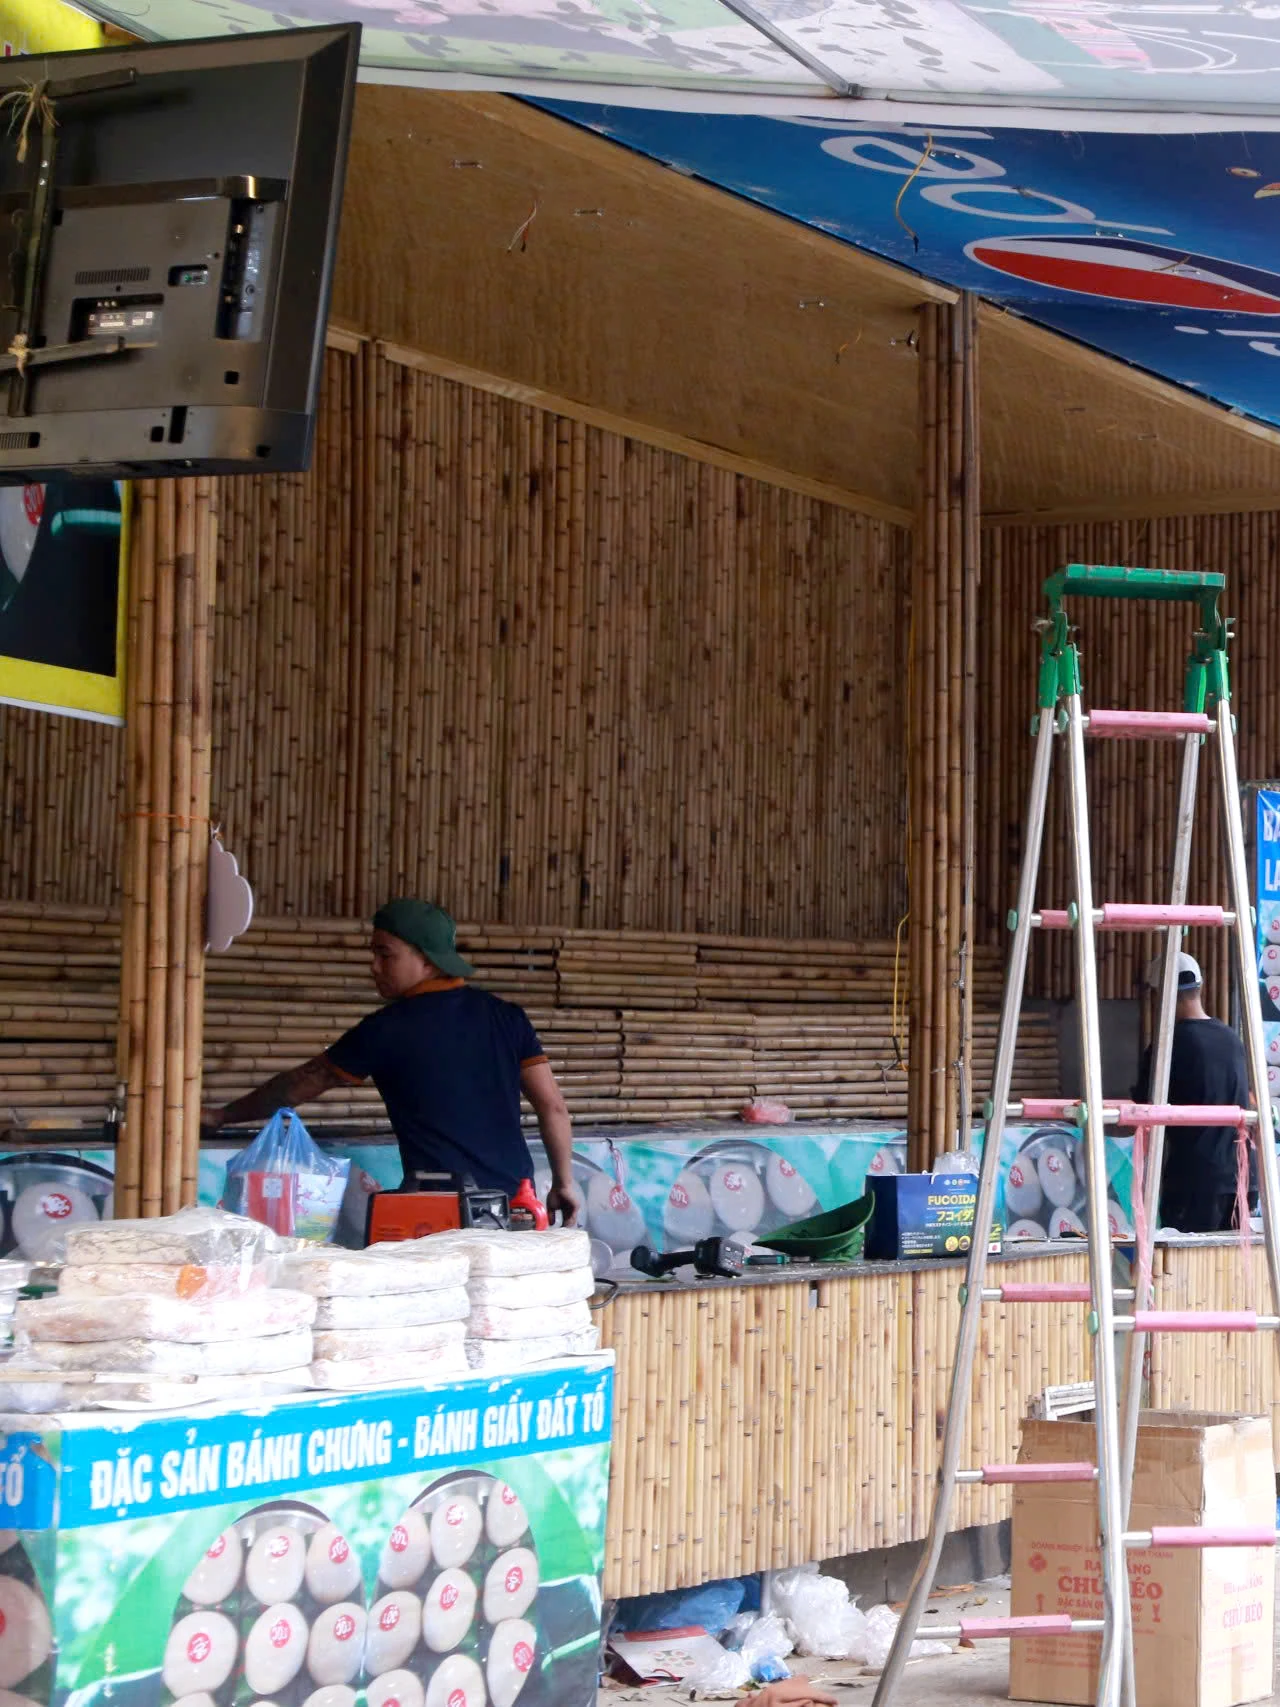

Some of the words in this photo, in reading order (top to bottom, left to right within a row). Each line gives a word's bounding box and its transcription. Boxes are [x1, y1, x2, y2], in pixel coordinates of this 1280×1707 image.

[927, 1194, 976, 1206] FUCOIDA
[936, 1209, 974, 1222] フコイダ
[90, 1447, 153, 1517] ĐẶC
[160, 1429, 221, 1499] SẢN
[226, 1428, 303, 1489] BÁNH
[414, 1404, 479, 1459] BÁNH
[537, 1381, 577, 1440] ĐẤT
[1130, 1576, 1163, 1600] ÉO
